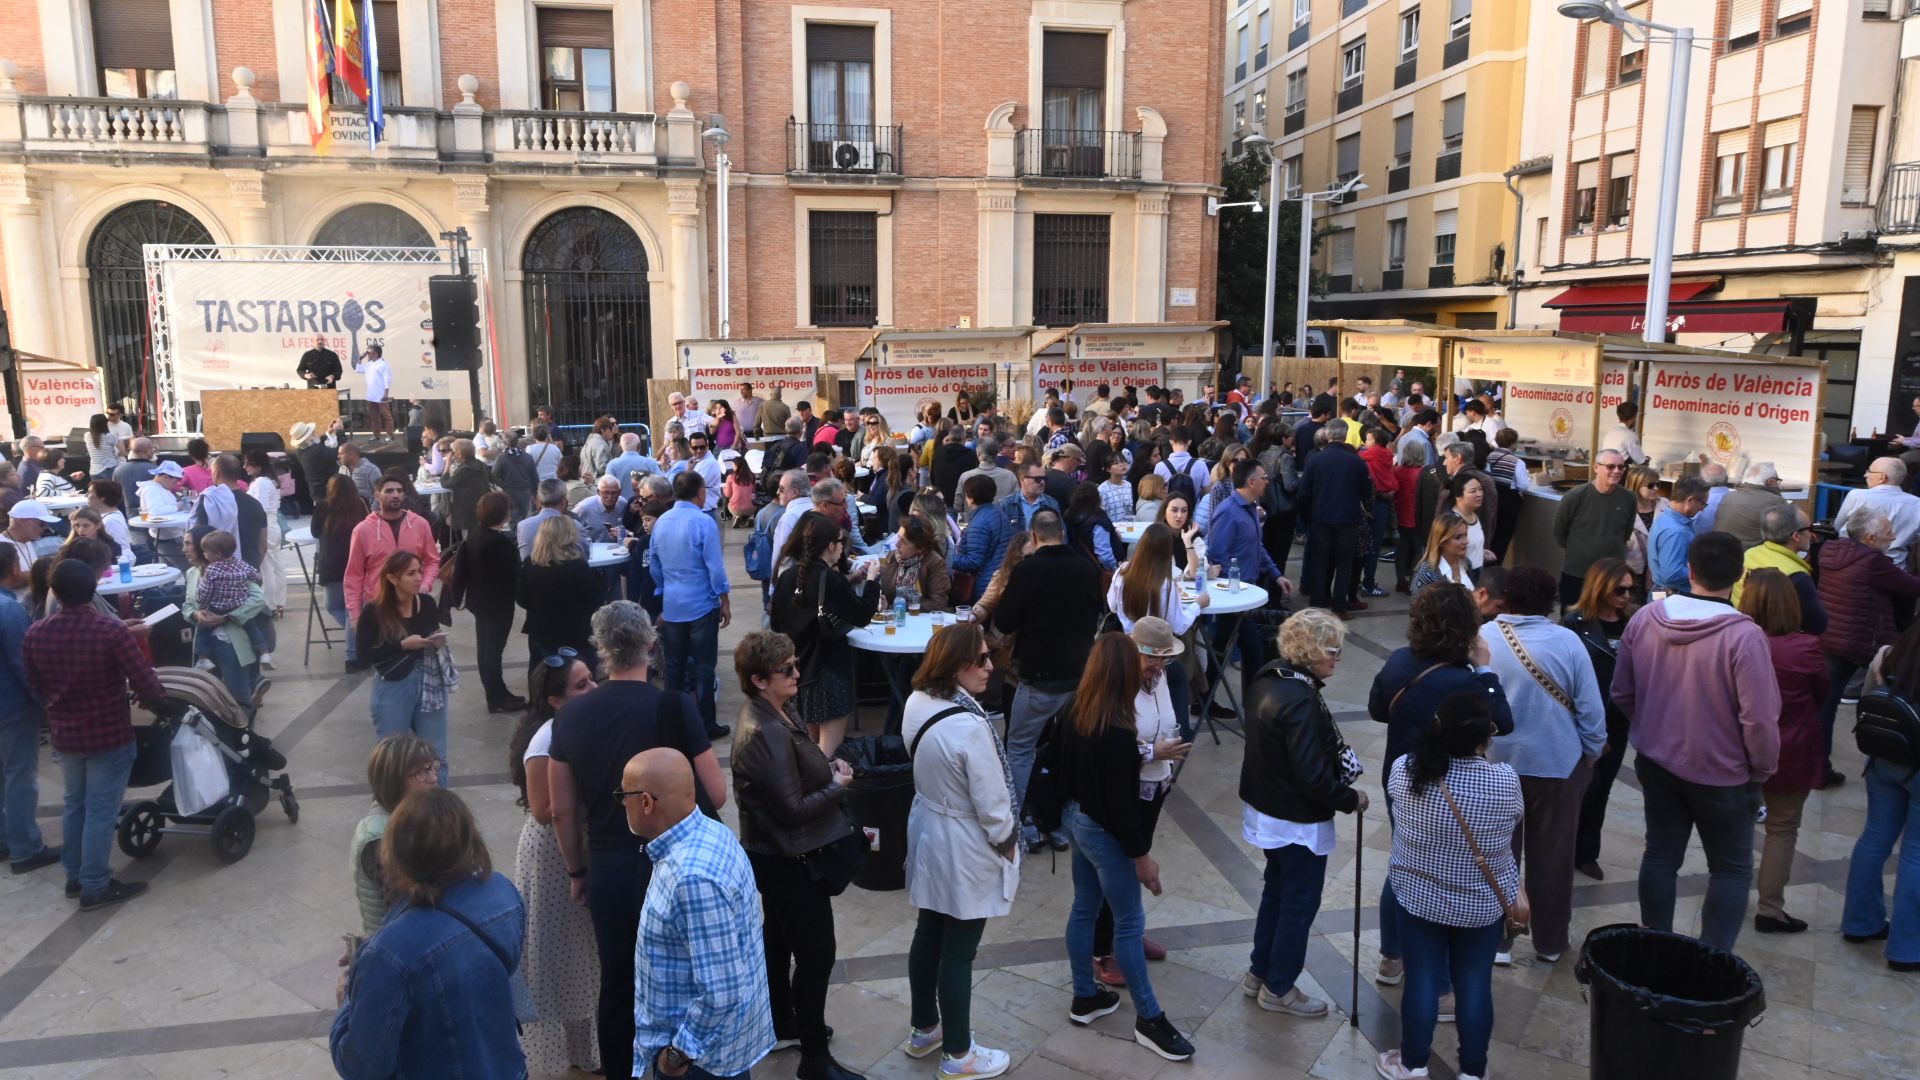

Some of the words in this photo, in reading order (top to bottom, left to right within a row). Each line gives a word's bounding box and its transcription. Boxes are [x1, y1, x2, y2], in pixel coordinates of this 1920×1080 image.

[332, 130, 388, 142] OVINCL
[282, 337, 295, 349] LA
[297, 337, 330, 349] FESA
[333, 337, 347, 348] DE
[735, 367, 751, 376] de
[864, 367, 902, 380] Arròs
[907, 367, 924, 379] de
[928, 365, 989, 378] València
[1039, 361, 1075, 374] Arròs
[1079, 360, 1096, 373] de
[1099, 359, 1158, 372] València
[28, 378, 94, 391] València
[695, 380, 766, 390] Denominció
[1655, 370, 1701, 390] Arròs
[1706, 372, 1727, 391] de
[1734, 373, 1813, 397] València
[1510, 386, 1574, 403] Denominació
[1653, 394, 1740, 417] Denominació
